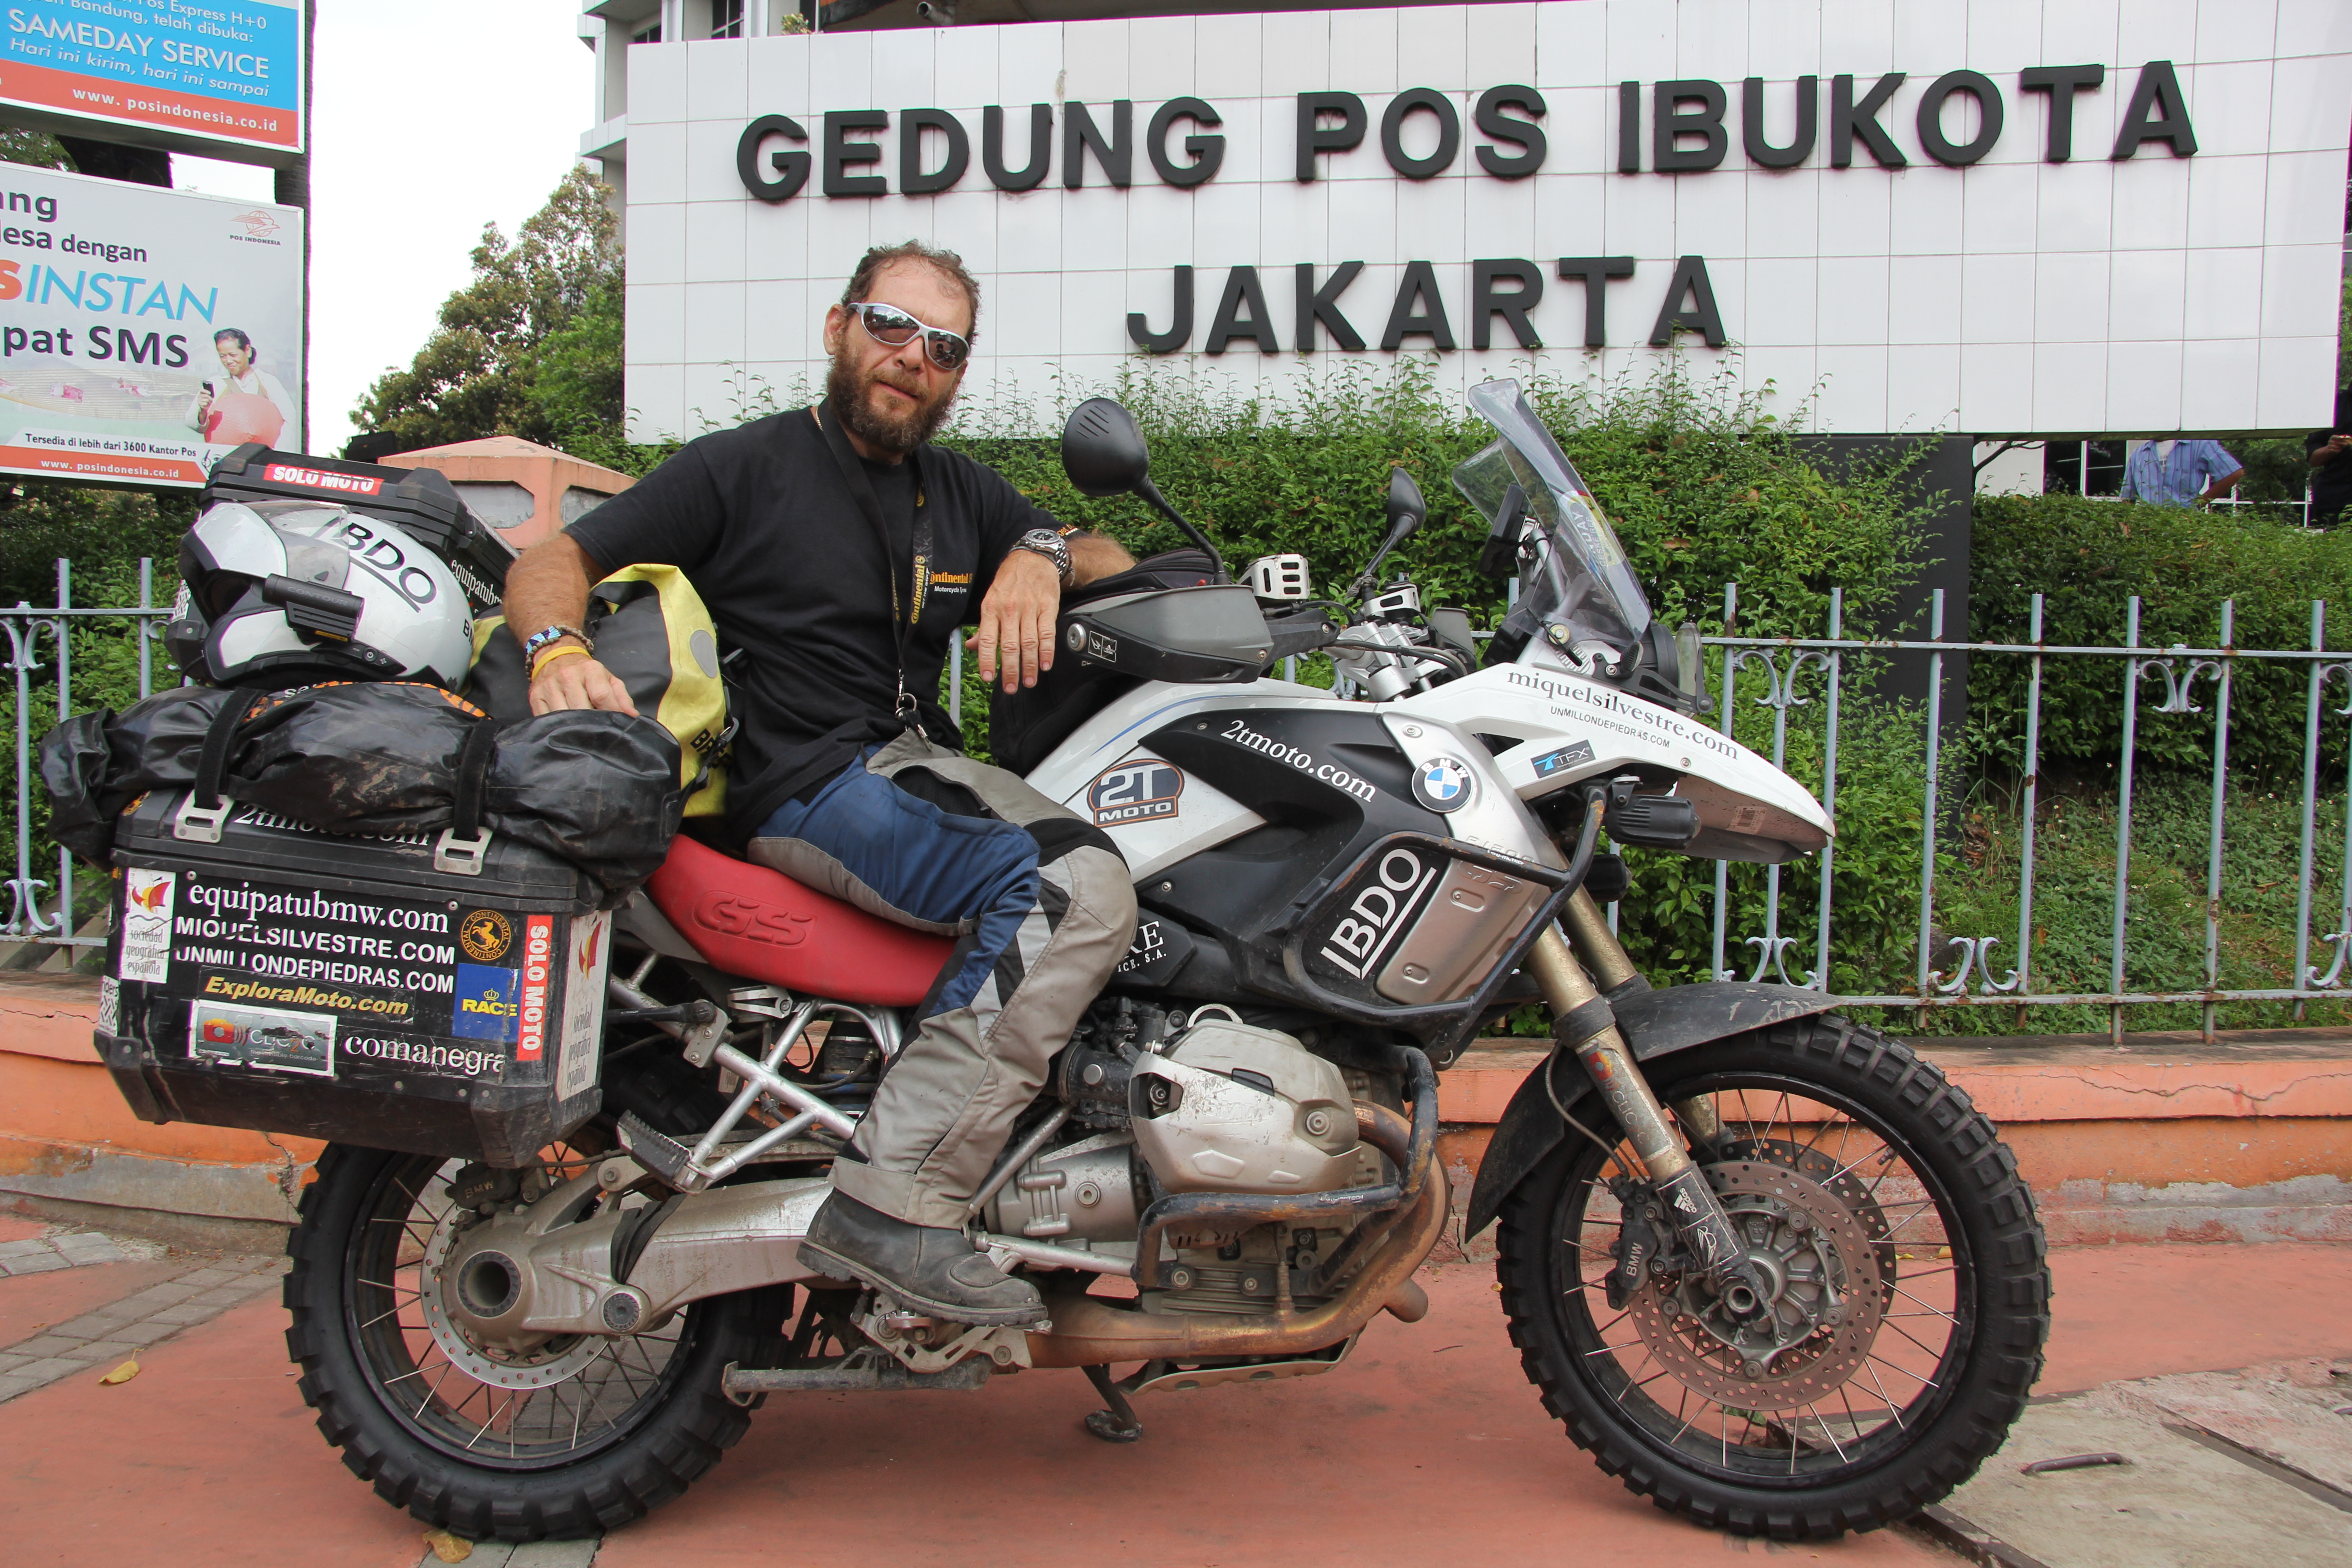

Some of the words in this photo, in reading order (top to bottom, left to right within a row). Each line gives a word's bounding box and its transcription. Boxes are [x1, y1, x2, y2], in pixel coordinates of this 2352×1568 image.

[71, 0, 148, 24] Bandung,
[153, 13, 192, 31] telah
[197, 21, 254, 43] dibuka:
[170, 0, 226, 22] Express
[231, 11, 267, 29] H+0
[8, 8, 155, 58] SAMEDAY
[162, 39, 270, 79] SERVICE
[10, 37, 53, 58] Hari
[57, 47, 81, 63] ini
[86, 52, 137, 76] kirim,
[143, 63, 178, 81] hari
[183, 70, 205, 86] ini
[208, 78, 270, 97] sampai
[72, 88, 121, 106] www.
[127, 98, 278, 132] posindonesia.co.id
[736, 95, 1226, 203] GEDUNG
[1296, 84, 1548, 183] POS
[1618, 60, 2199, 175] IBUKOTA
[0, 219, 53, 250] esa
[61, 234, 147, 263] dengan
[245, 236, 281, 246] INDONESIA
[1127, 255, 1728, 355] JAKARTA
[88, 326, 190, 368] SMS
[25, 432, 66, 446] Tersedia
[68, 437, 77, 447] di
[79, 438, 101, 449] lebih
[103, 441, 121, 451] dari
[123, 441, 147, 452] 3600
[149, 444, 179, 456] Kantor
[181, 447, 196, 457] Pos
[41, 460, 73, 470] www.
[77, 461, 179, 478] posindonesia.co.id
[273, 466, 319, 485] SOLO
[320, 474, 374, 493] MOTO
[288, 586, 348, 606] CONTOUR
[911, 564, 925, 624] Continental
[1507, 671, 1738, 760] miquelsilvestre.com
[1550, 706, 1670, 749] UNMILLONDEPIEDRAS.COM
[1220, 719, 1377, 803] 2tmoto.com
[1421, 758, 1469, 779] BMW
[1099, 764, 1169, 808] 2T
[1099, 801, 1172, 822] MOTO
[189, 882, 450, 933] equipatubmw.com
[470, 911, 509, 941] CONTINENTAL
[695, 896, 813, 947] GS
[175, 916, 455, 965] MIQUELSILVESTRE.COM
[463, 933, 502, 959] CONTINENTAL
[526, 925, 549, 982] SOLO
[1145, 949, 1167, 963] S.A.
[205, 975, 409, 1015] ExploraMoto.com
[461, 999, 518, 1017] RACE
[522, 986, 545, 1051] MOTO
[289, 1053, 317, 1061] barcode
[344, 1036, 505, 1076] comanegra
[464, 1180, 494, 1199] BMW
[1680, 1187, 1698, 1214] adidas
[1626, 1242, 1643, 1276] BMW
